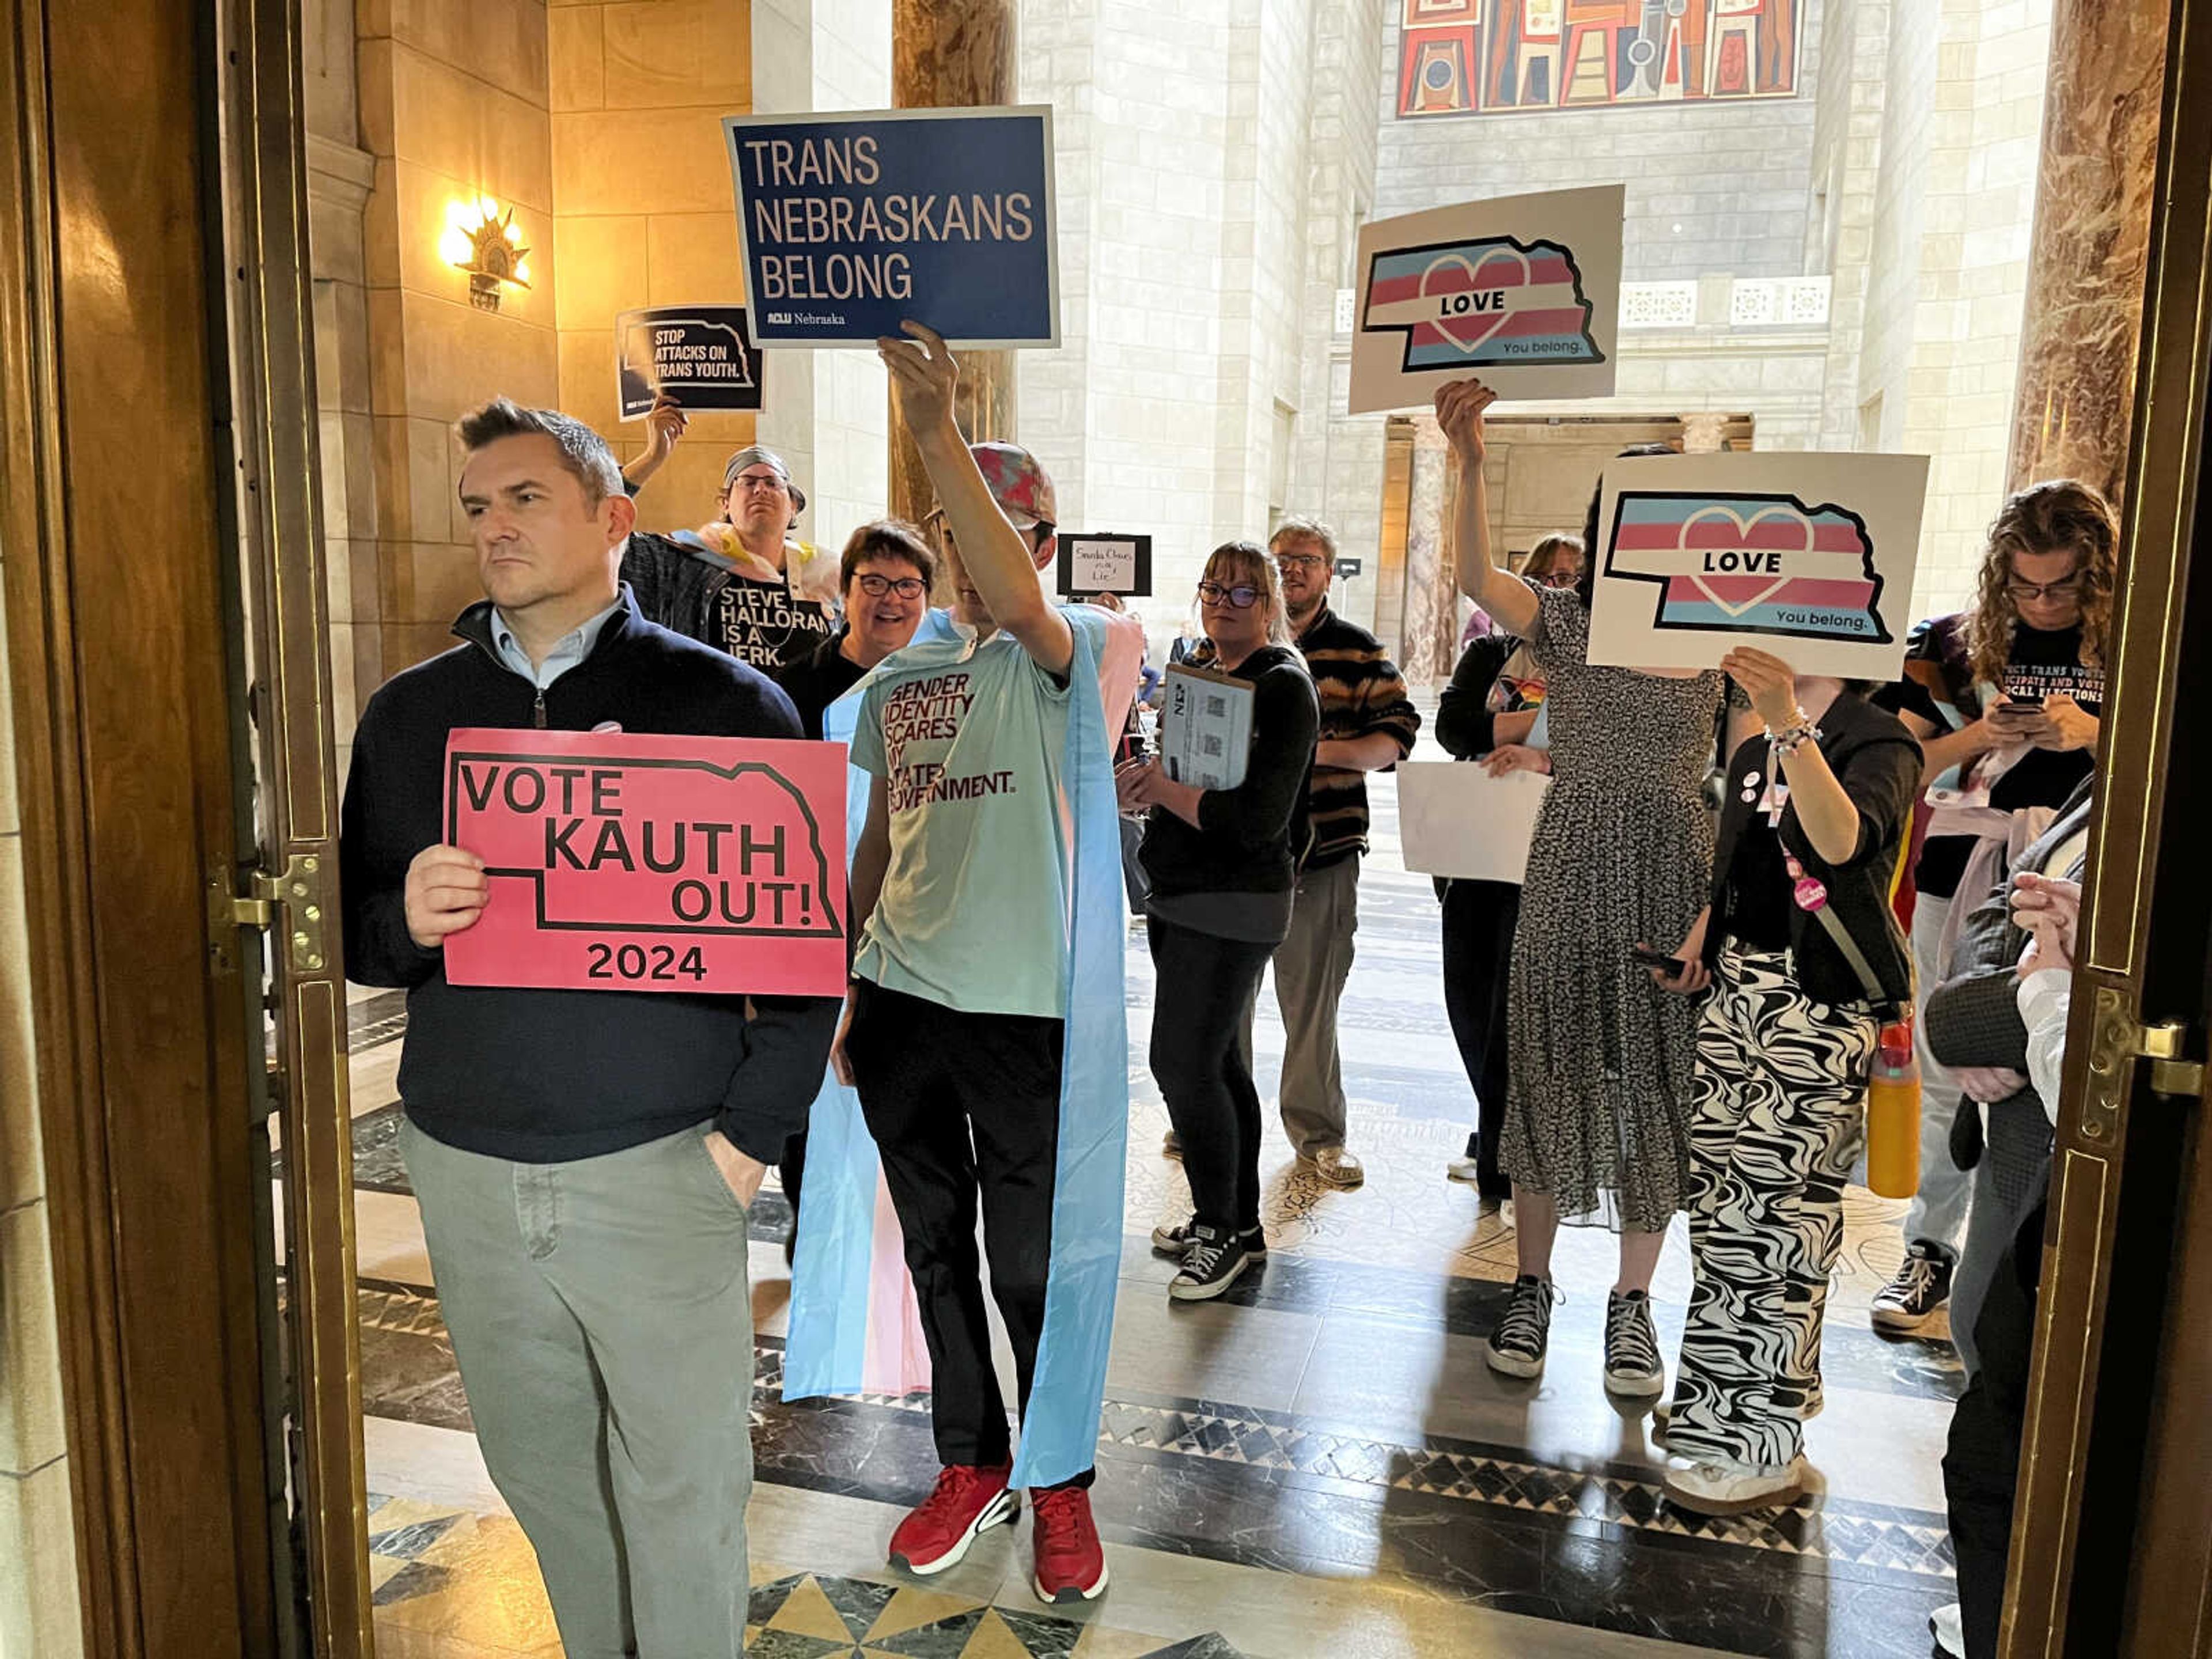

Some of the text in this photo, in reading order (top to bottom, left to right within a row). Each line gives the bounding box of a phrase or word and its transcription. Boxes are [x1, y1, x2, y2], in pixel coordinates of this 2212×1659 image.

[745, 135, 880, 187] TRANS
[755, 192, 1033, 244] NEBRASKANS
[761, 252, 913, 300] BELONG
[1441, 290, 1505, 315] LOVE
[794, 312, 846, 325] Nebraska
[654, 328, 685, 345] STOP
[1504, 342, 1584, 355] You belong.
[654, 345, 727, 362] ATTACKS ON
[654, 362, 740, 378] TRANS YOUTH.
[1703, 552, 1782, 573] LOVE
[721, 587, 787, 609] STEVE
[721, 606, 830, 635] HALLORAN
[1776, 609, 1869, 631] You belong.
[721, 624, 763, 646] IS A
[2031, 665, 2067, 675] TRANS
[2051, 677, 2073, 687] AND
[889, 673, 969, 702] GENDER
[884, 692, 975, 726] IDENTITY
[884, 717, 957, 748] SCARES
[461, 764, 623, 817] VOTE
[544, 817, 786, 877] KAUTH
[671, 879, 811, 926] OUT!
[586, 942, 707, 981] 2024
